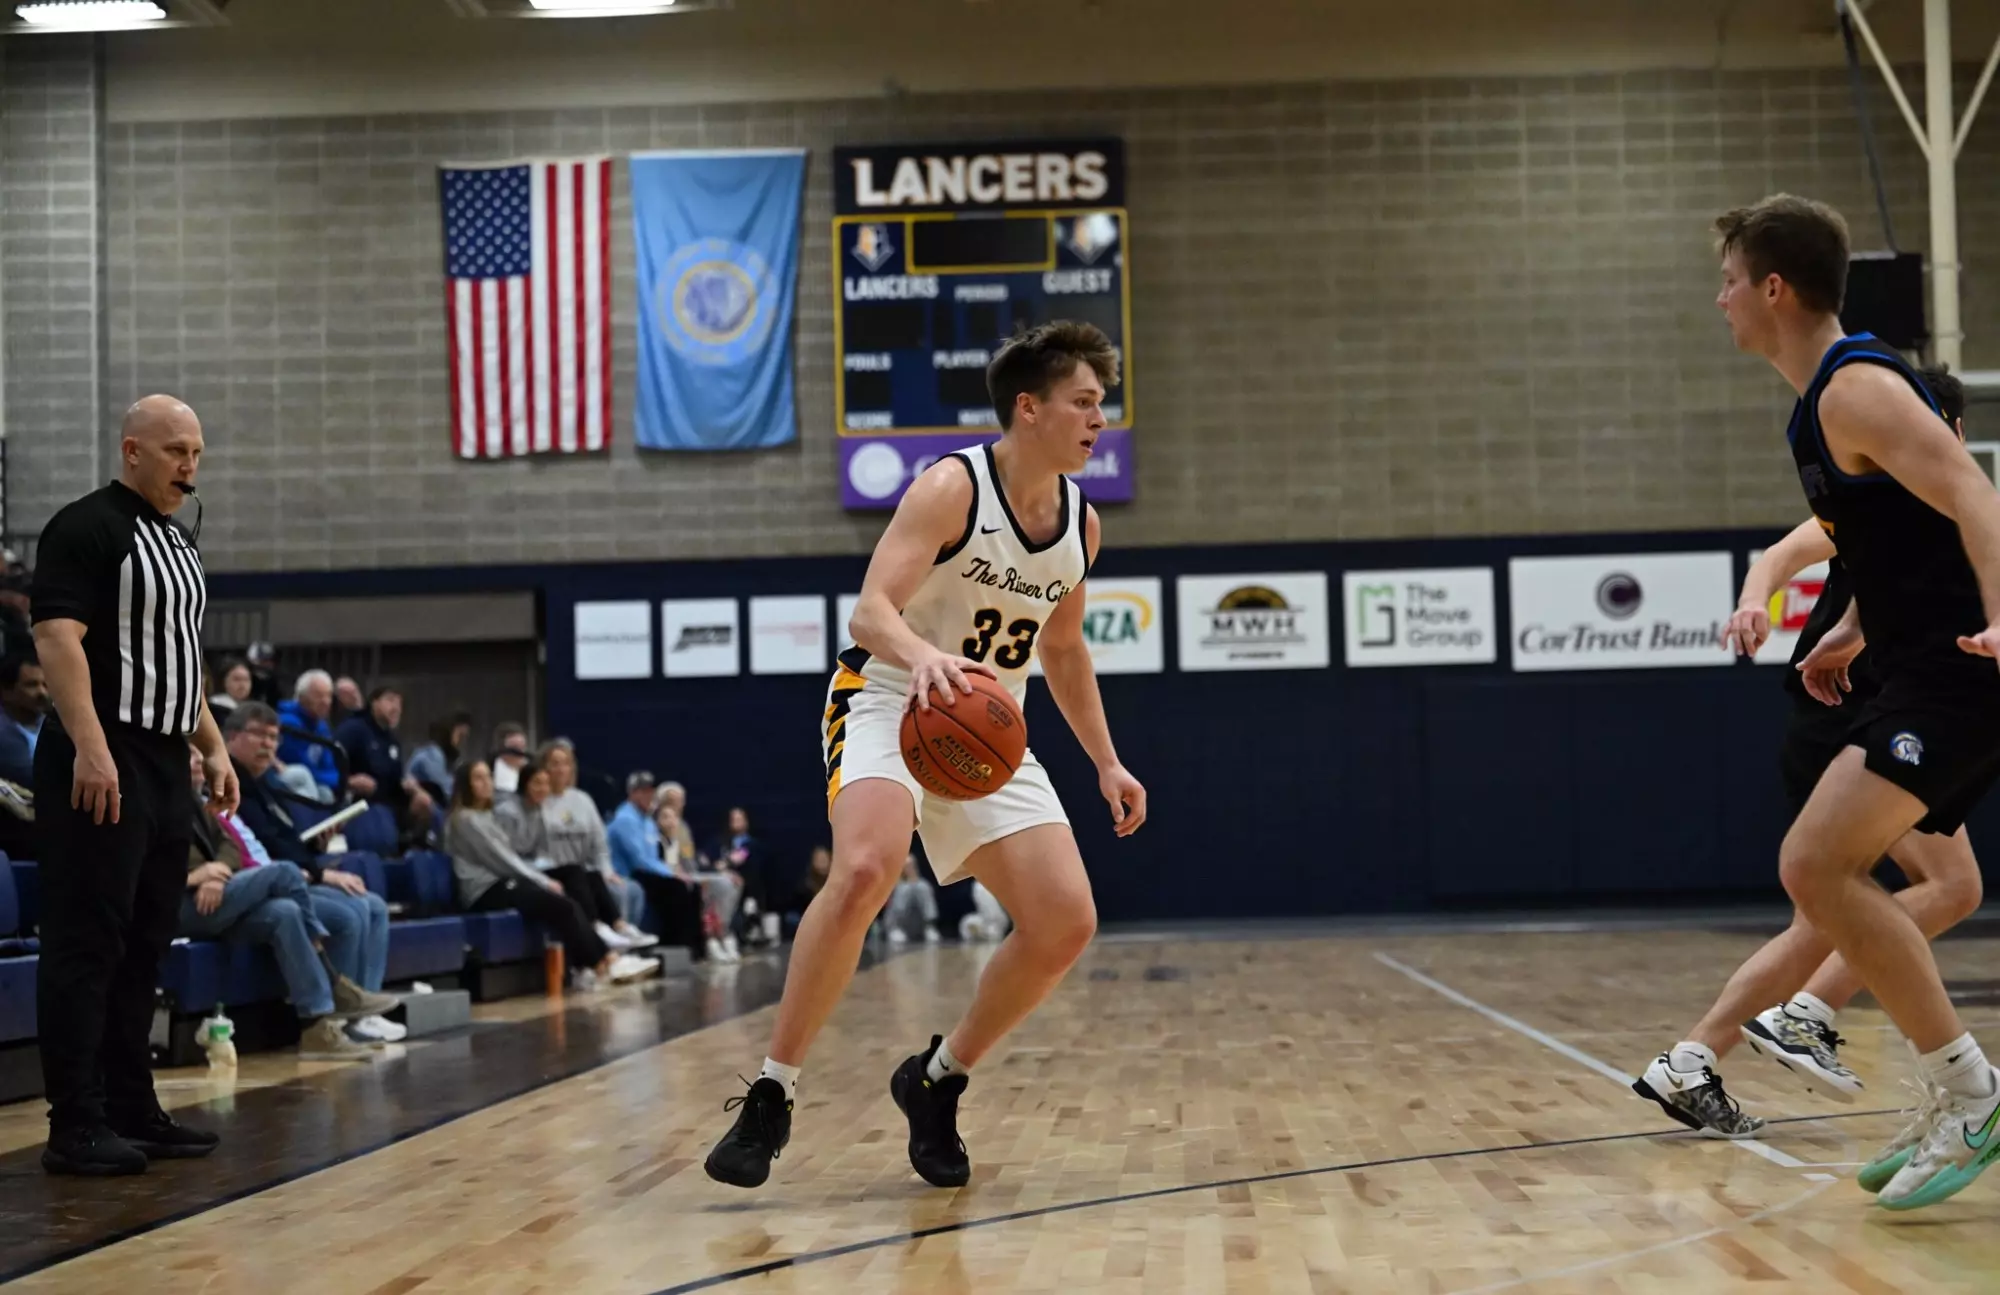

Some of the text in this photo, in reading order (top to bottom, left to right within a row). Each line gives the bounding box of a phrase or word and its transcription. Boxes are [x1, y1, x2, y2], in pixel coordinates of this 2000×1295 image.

[852, 153, 1108, 206] LANCERS
[845, 275, 939, 301] LANCERS
[1042, 270, 1112, 293] GUEST
[962, 557, 998, 586] The
[999, 567, 1042, 599] River
[1406, 583, 1447, 603] The
[1083, 609, 1138, 642] NZA
[1212, 616, 1295, 638] MWH
[1406, 607, 1471, 625] Move
[963, 609, 1039, 669] 33
[1407, 629, 1484, 651] Group
[1519, 620, 1721, 654] CorTrust Bank
